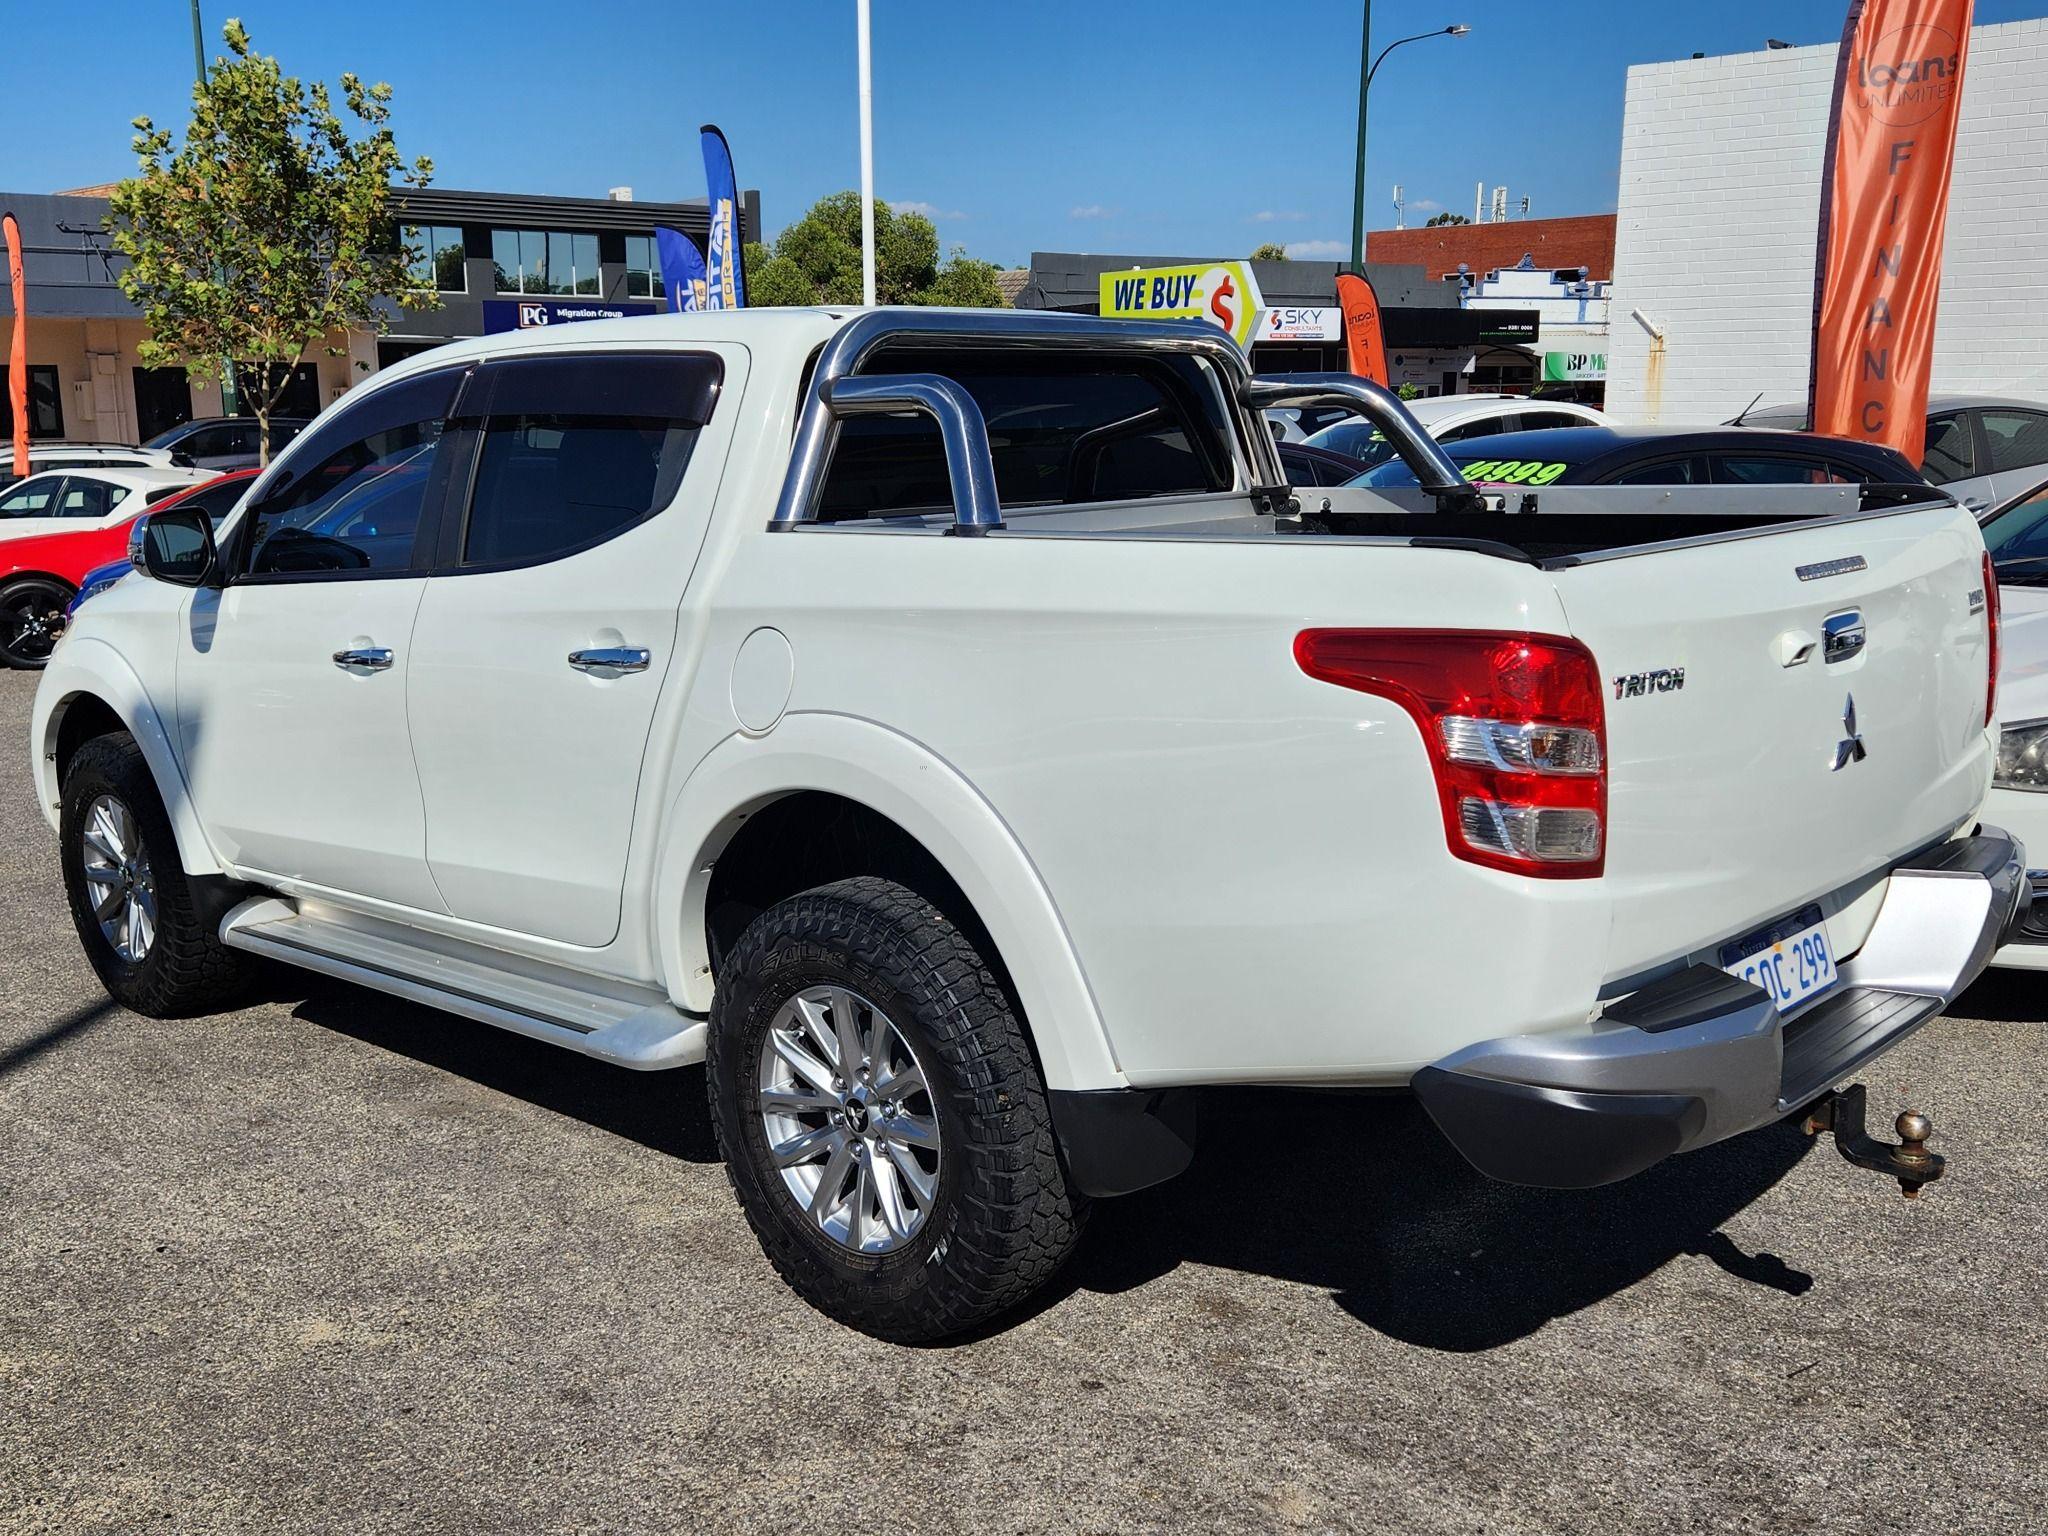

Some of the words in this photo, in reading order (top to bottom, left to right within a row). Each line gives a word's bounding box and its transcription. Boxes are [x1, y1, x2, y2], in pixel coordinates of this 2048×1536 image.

[1115, 278, 1146, 311] WE
[1151, 274, 1197, 310] BUY
[522, 307, 548, 325] PG
[557, 308, 597, 319] Migration
[599, 309, 624, 319] Group
[1285, 309, 1323, 324] SKY
[1567, 354, 1588, 371] BP
[1612, 667, 1685, 700] TRITON
